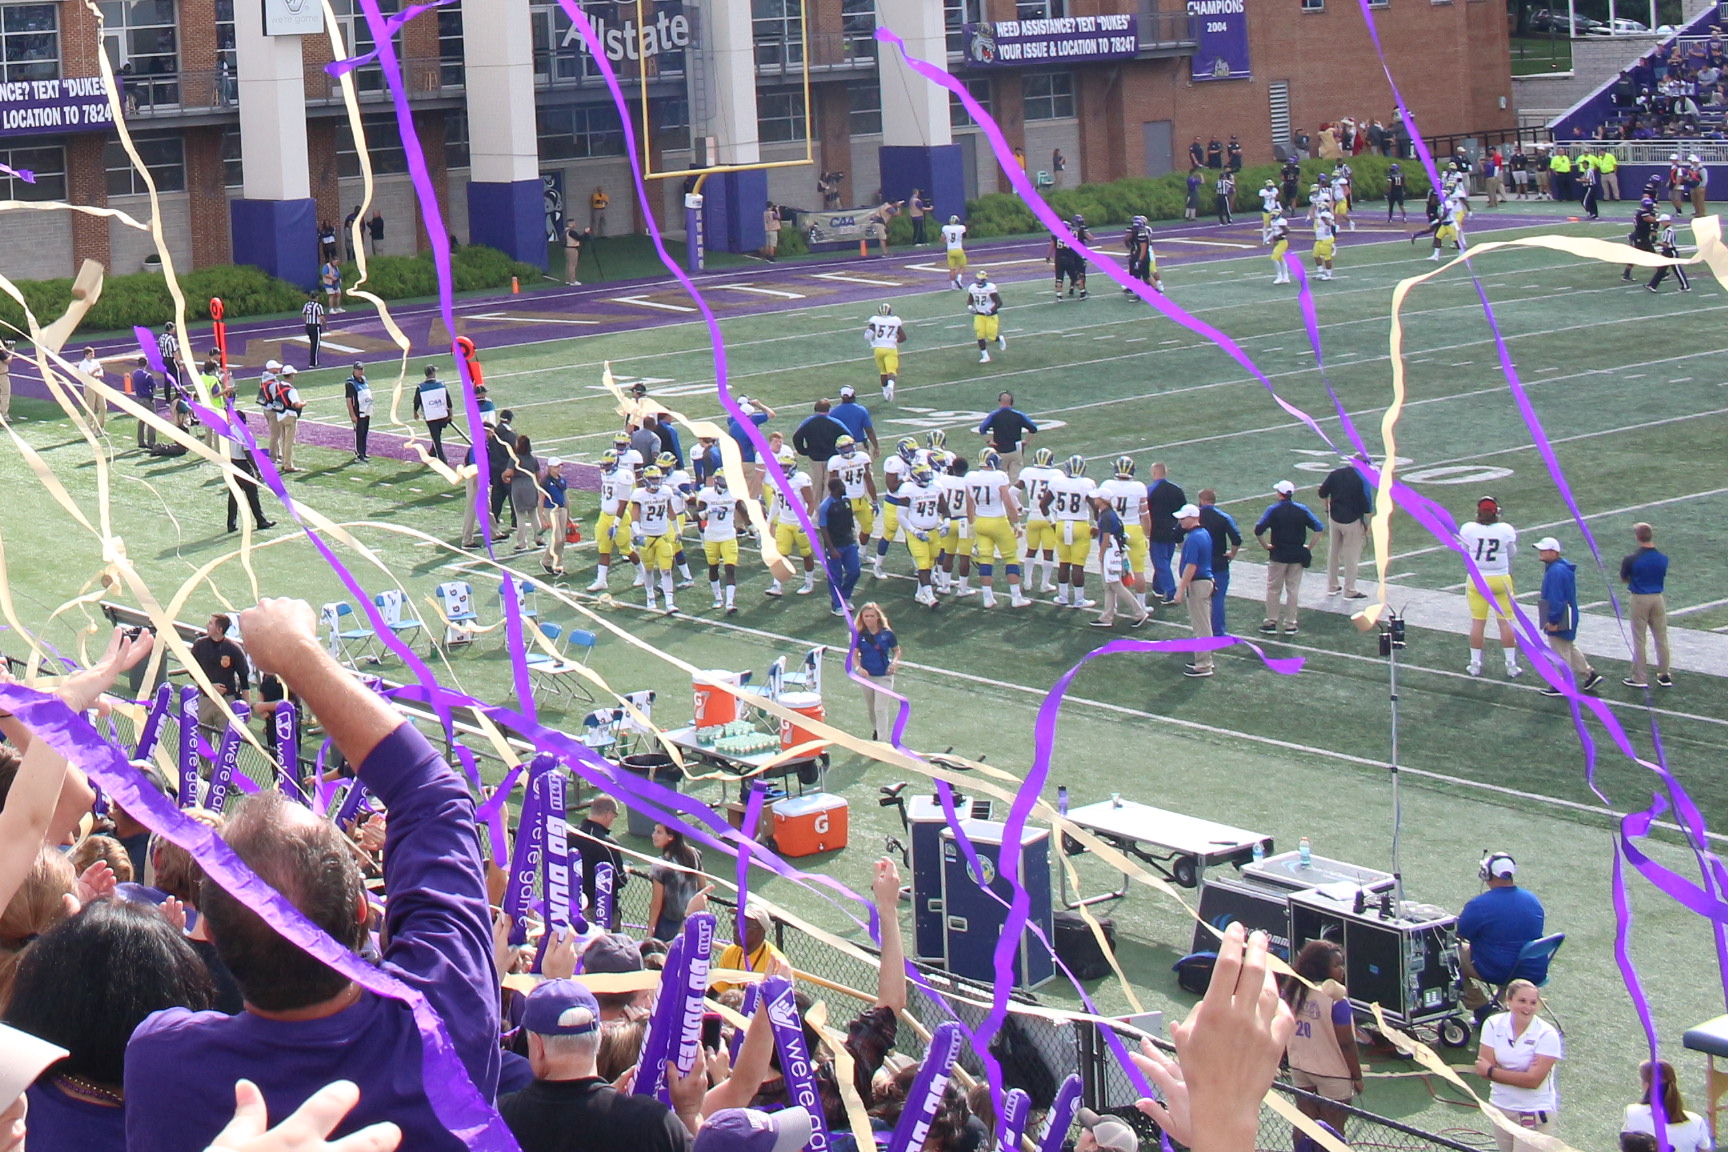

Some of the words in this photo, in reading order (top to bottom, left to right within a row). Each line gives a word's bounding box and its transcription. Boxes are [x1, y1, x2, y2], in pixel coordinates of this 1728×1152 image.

[561, 10, 690, 61] Allstate
[996, 21, 1020, 38] NEED
[1021, 17, 1076, 36] ASSISTANCE?
[1077, 16, 1096, 32] TEXT
[1206, 22, 1228, 32] 2004
[998, 43, 1022, 60] YOUR
[1023, 41, 1048, 59] ISSUE
[1049, 41, 1057, 56] &
[1058, 37, 1098, 56] LOCATION
[1098, 37, 1109, 54] TO
[1110, 36, 1135, 53] 78247
[31, 80, 60, 100] TEXT
[3, 106, 62, 130] LOCATION
[63, 105, 80, 125] TO
[82, 102, 113, 124] 7824
[829, 216, 855, 227] CAA
[306, 304, 313, 314] S
[876, 325, 896, 339] 57
[845, 467, 865, 486] 45
[972, 485, 991, 506] 71
[1056, 491, 1082, 514] 58
[645, 504, 666, 522] 24
[916, 500, 936, 517] 43
[1474, 537, 1501, 563] 12
[693, 692, 704, 707] G
[188, 725, 198, 764] we're
[220, 740, 240, 782] we're
[548, 773, 563, 811] JMU
[814, 815, 829, 834] G
[546, 814, 568, 858] GO
[698, 919, 712, 955] JMU
[688, 957, 710, 990] GO
[1295, 1019, 1312, 1039] 20
[785, 1036, 815, 1107] we're
[922, 1072, 949, 1115] GO
